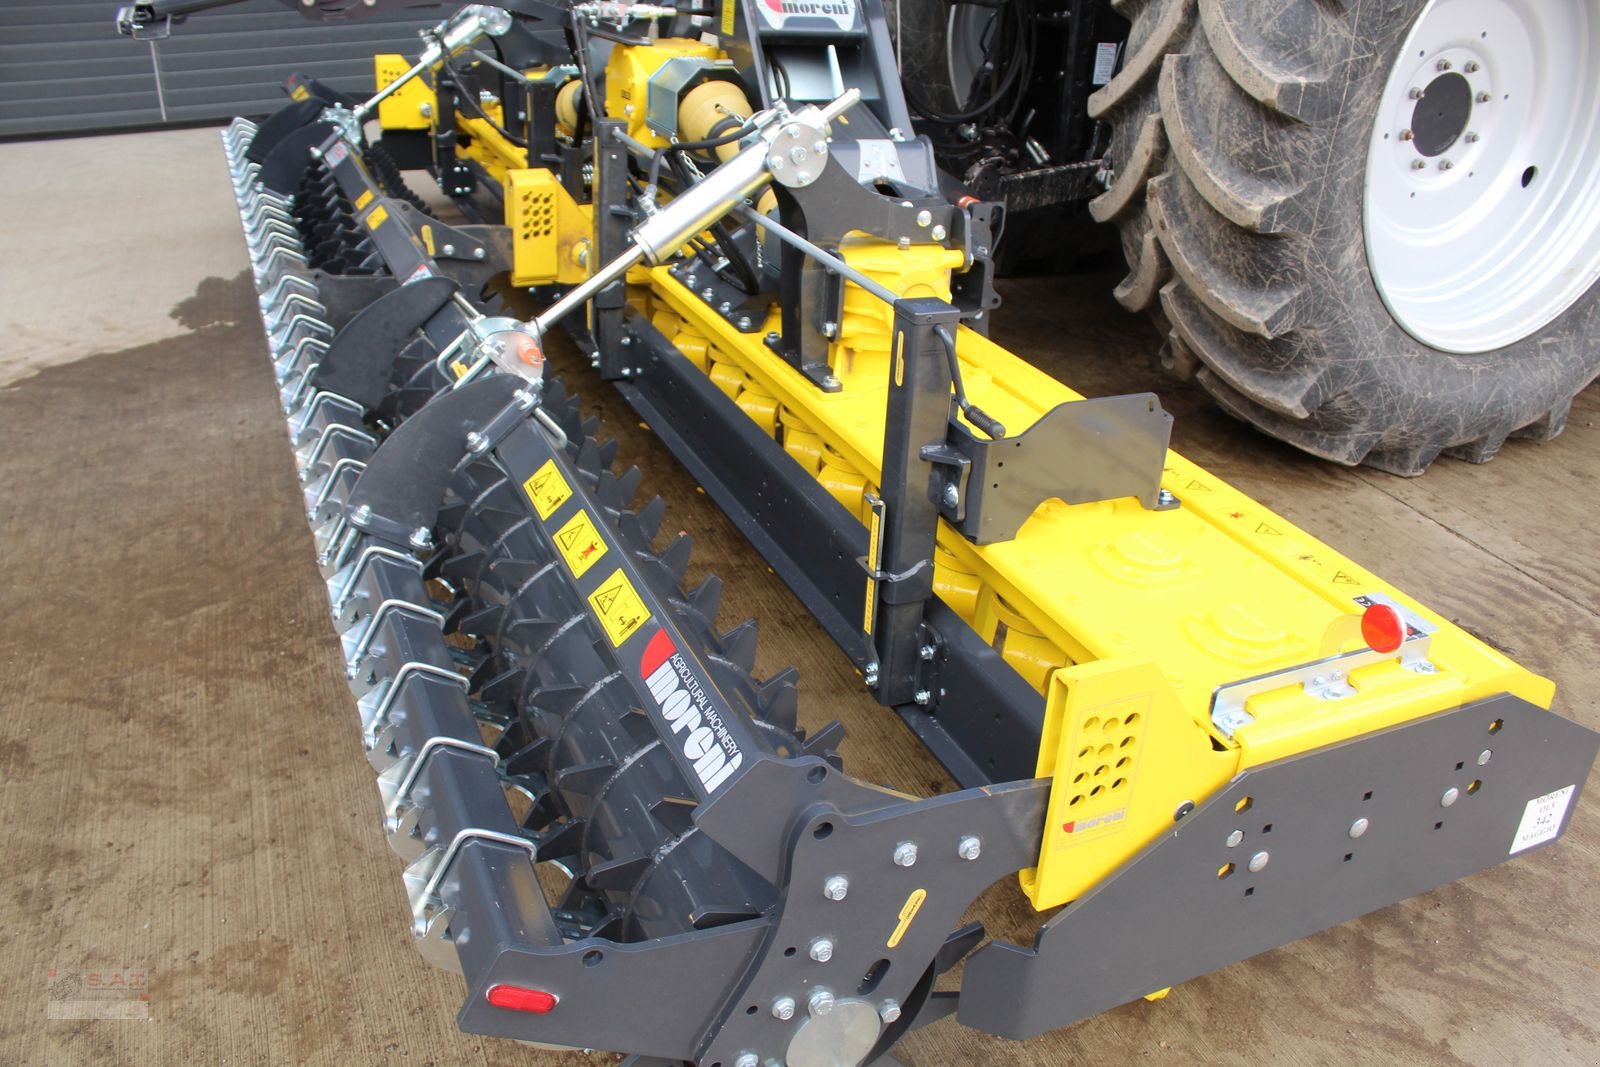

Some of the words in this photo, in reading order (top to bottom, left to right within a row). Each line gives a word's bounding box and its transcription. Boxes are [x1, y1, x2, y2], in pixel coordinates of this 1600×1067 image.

[782, 0, 849, 14] moreni
[645, 660, 743, 794] moreni
[670, 653, 704, 711] AGRICULTURAL
[704, 706, 740, 757] MACHINERY
[1075, 807, 1125, 832] moreni
